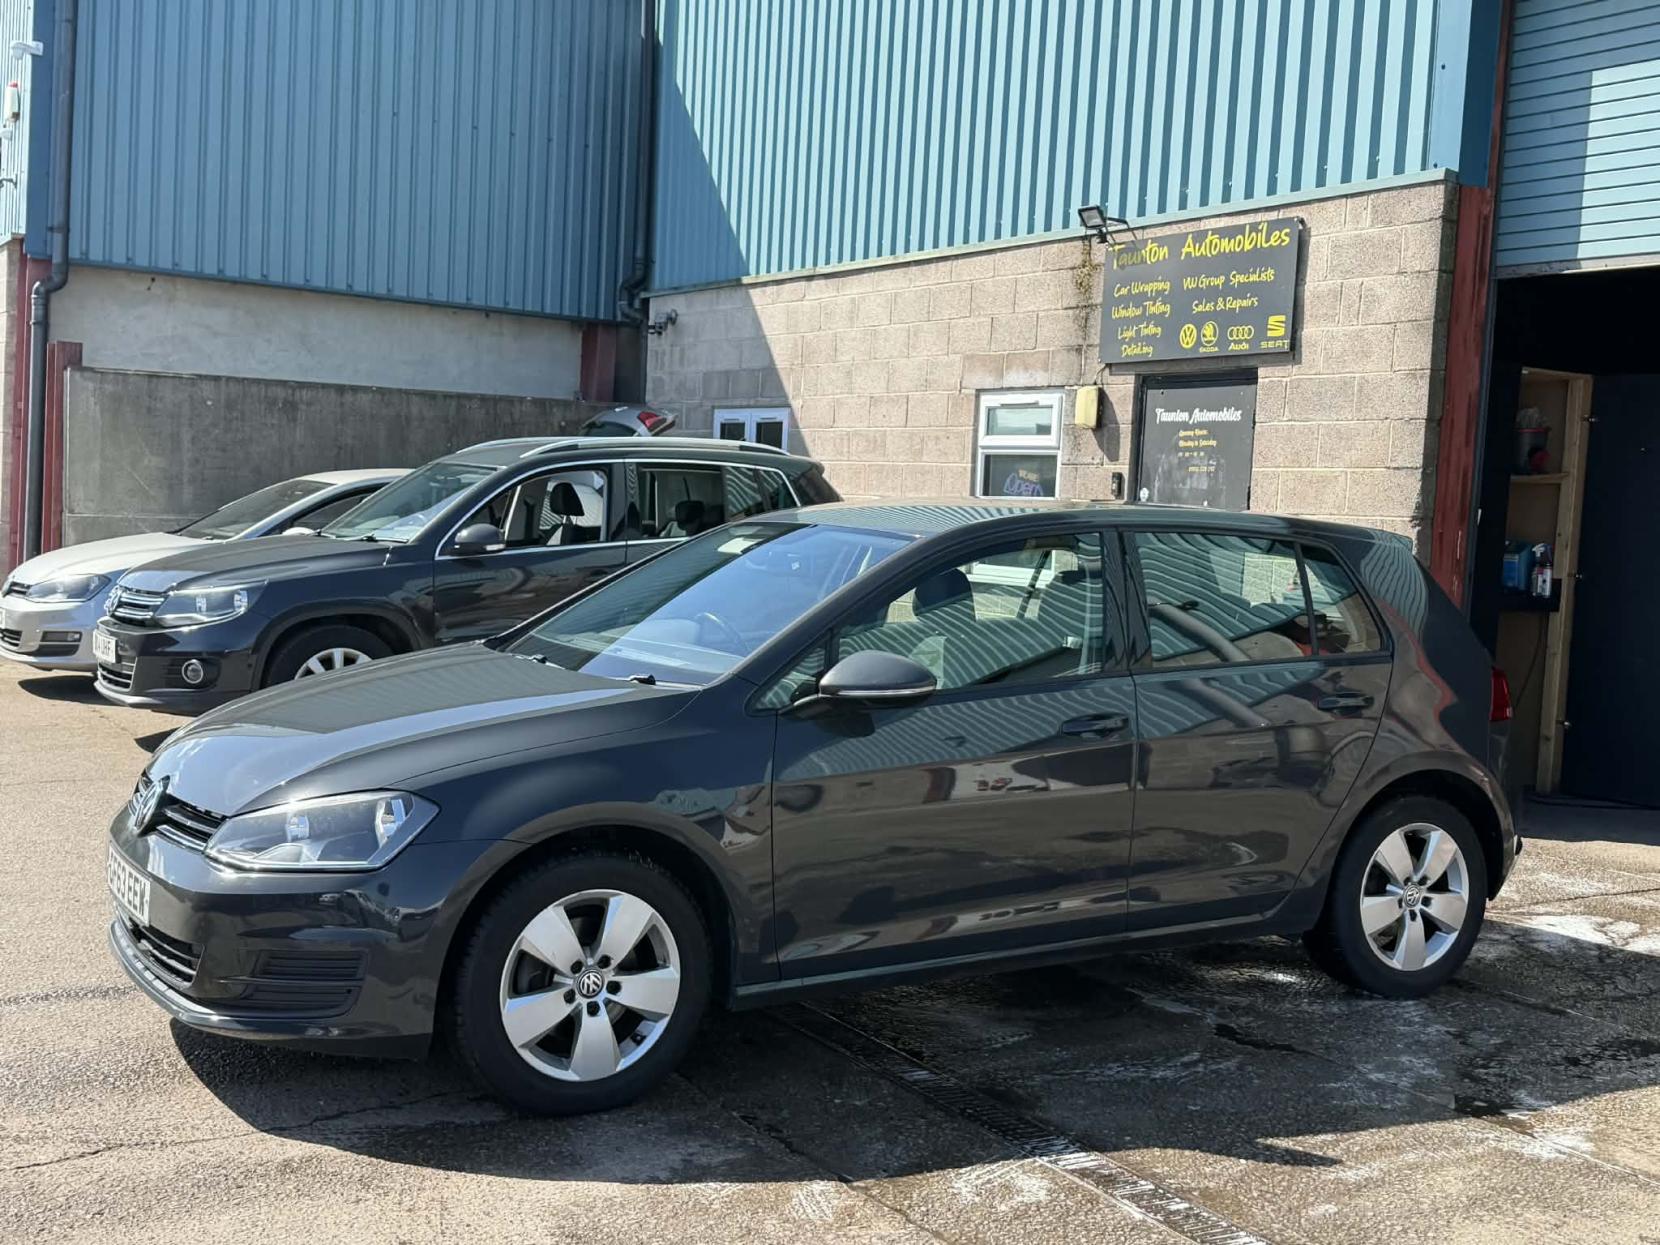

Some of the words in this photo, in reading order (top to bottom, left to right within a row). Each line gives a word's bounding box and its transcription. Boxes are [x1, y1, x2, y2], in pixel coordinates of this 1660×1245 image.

[1108, 240, 1169, 269] Taunton
[1181, 222, 1291, 260] Automobiles
[1113, 283, 1131, 297] Car
[1131, 276, 1170, 297] Wrapping
[1198, 274, 1225, 289] Group
[1229, 266, 1275, 288] Specialists
[1111, 302, 1142, 319] Window
[1143, 298, 1170, 317] Tinting
[1192, 298, 1215, 314] Sales
[1216, 297, 1226, 311] &
[1226, 293, 1259, 313] Repairs
[1117, 326, 1138, 341] Light
[1138, 322, 1161, 337] Tinting
[1120, 343, 1153, 357] Detailing
[1227, 341, 1249, 350] Audi
[1260, 340, 1290, 349] SEAT
[1155, 408, 1190, 424] Taunton
[1189, 406, 1243, 424] Automobiles
